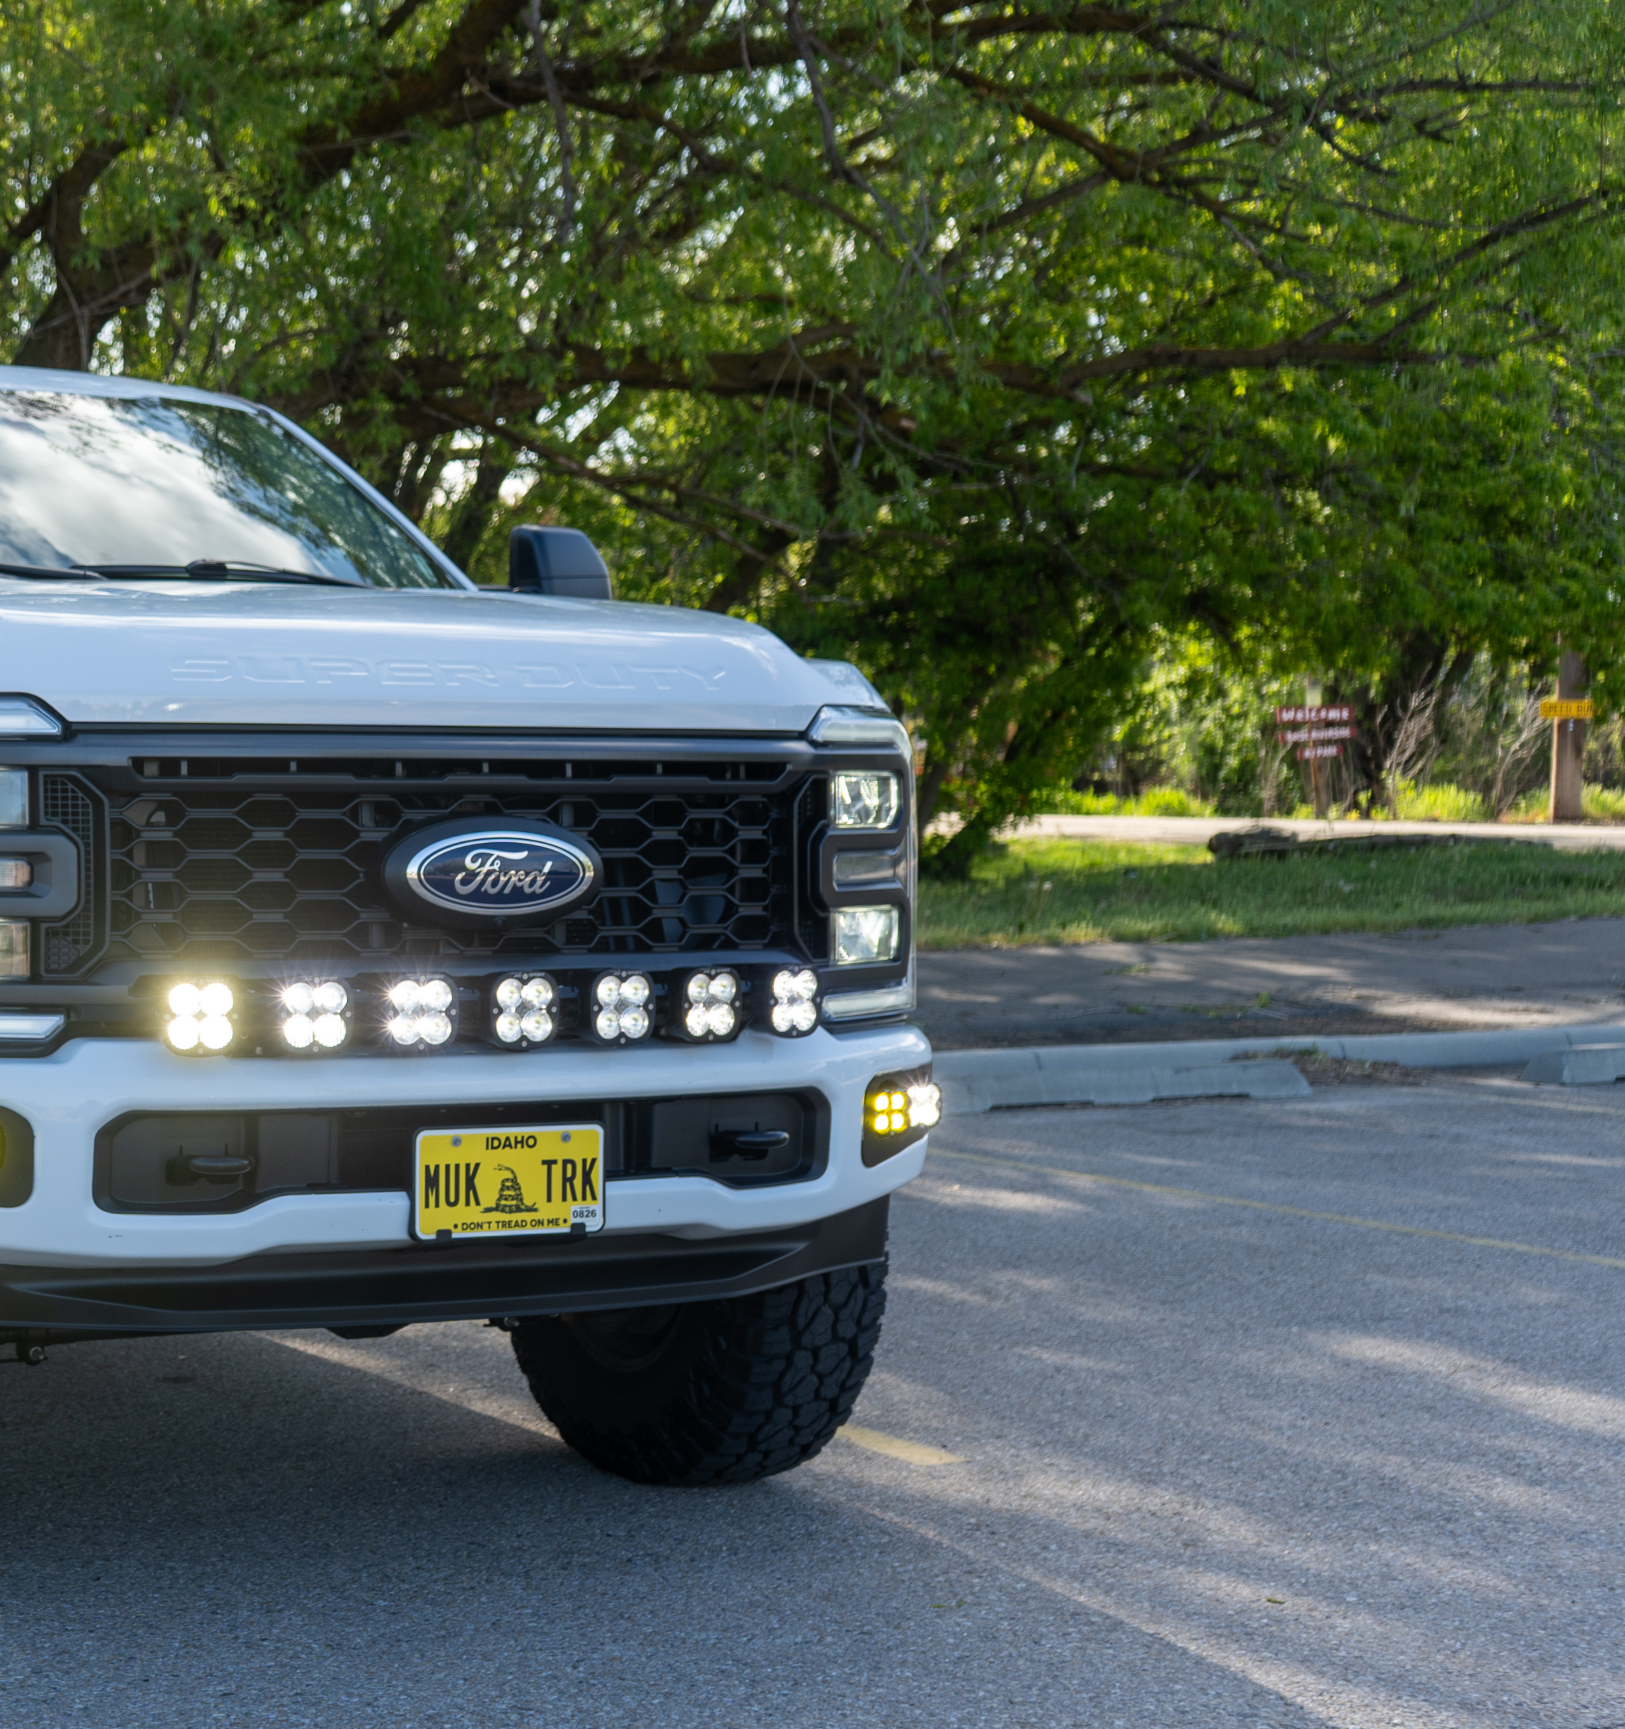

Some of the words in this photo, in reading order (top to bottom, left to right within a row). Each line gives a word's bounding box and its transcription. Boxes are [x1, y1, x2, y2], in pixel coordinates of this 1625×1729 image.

[168, 655, 499, 687] SUPER
[513, 661, 727, 692] DUTY
[1281, 706, 1350, 722] Welcome
[1542, 702, 1572, 717] SPEED
[454, 848, 553, 895] Ford
[485, 1135, 537, 1151] IDAHO
[424, 1162, 482, 1209] MUK
[541, 1157, 598, 1204] TRK
[572, 1209, 597, 1219] 0826
[461, 1221, 492, 1231] DON'T
[494, 1219, 528, 1230] TREAD
[529, 1218, 545, 1228] ON
[546, 1217, 561, 1227] ME
